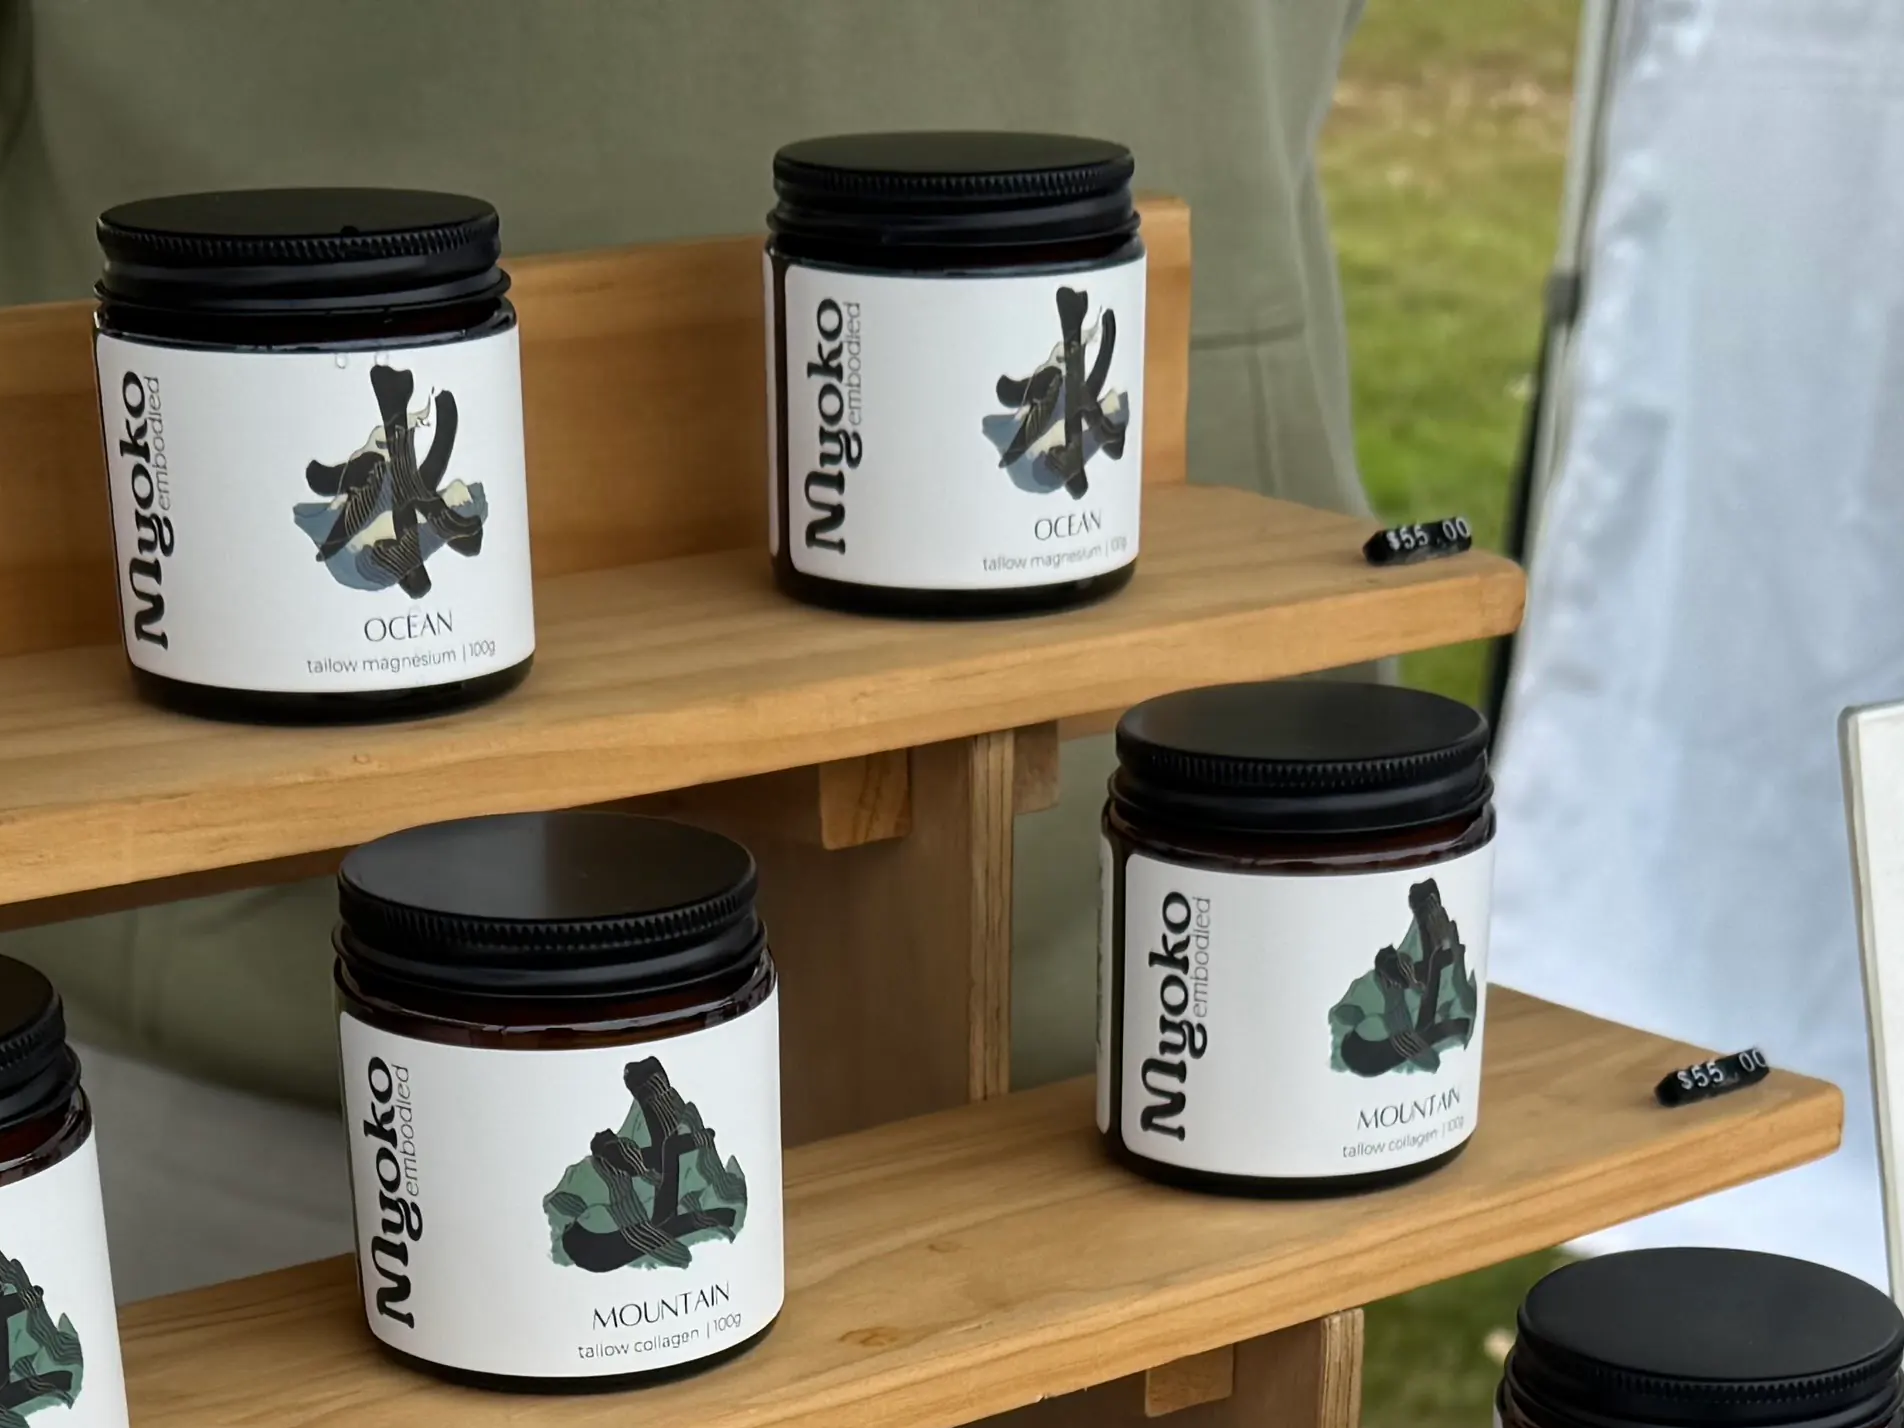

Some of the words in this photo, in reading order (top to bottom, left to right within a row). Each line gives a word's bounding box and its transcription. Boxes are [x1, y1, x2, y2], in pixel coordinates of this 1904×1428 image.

[844, 302, 862, 426] embodied
[144, 376, 172, 511] embodied
[806, 297, 862, 554] Myoko
[120, 370, 174, 650] Myoko
[1034, 509, 1102, 541] OCEAN
[306, 659, 358, 674] tallow
[362, 649, 456, 673] magnesium
[469, 640, 496, 657] 100g
[363, 610, 454, 642] OCEAN
[1140, 891, 1208, 1142] Myoko
[1191, 897, 1212, 1018] embodied
[396, 1064, 421, 1196] embodied
[1343, 1143, 1385, 1158] tallow
[1357, 1085, 1462, 1130] MOUNTAIN
[364, 1056, 423, 1328] Myoko
[578, 1343, 629, 1359] tallow
[634, 1329, 699, 1352] collagen
[714, 1313, 741, 1332] 100g
[592, 1281, 730, 1330] MOUNTAIN
